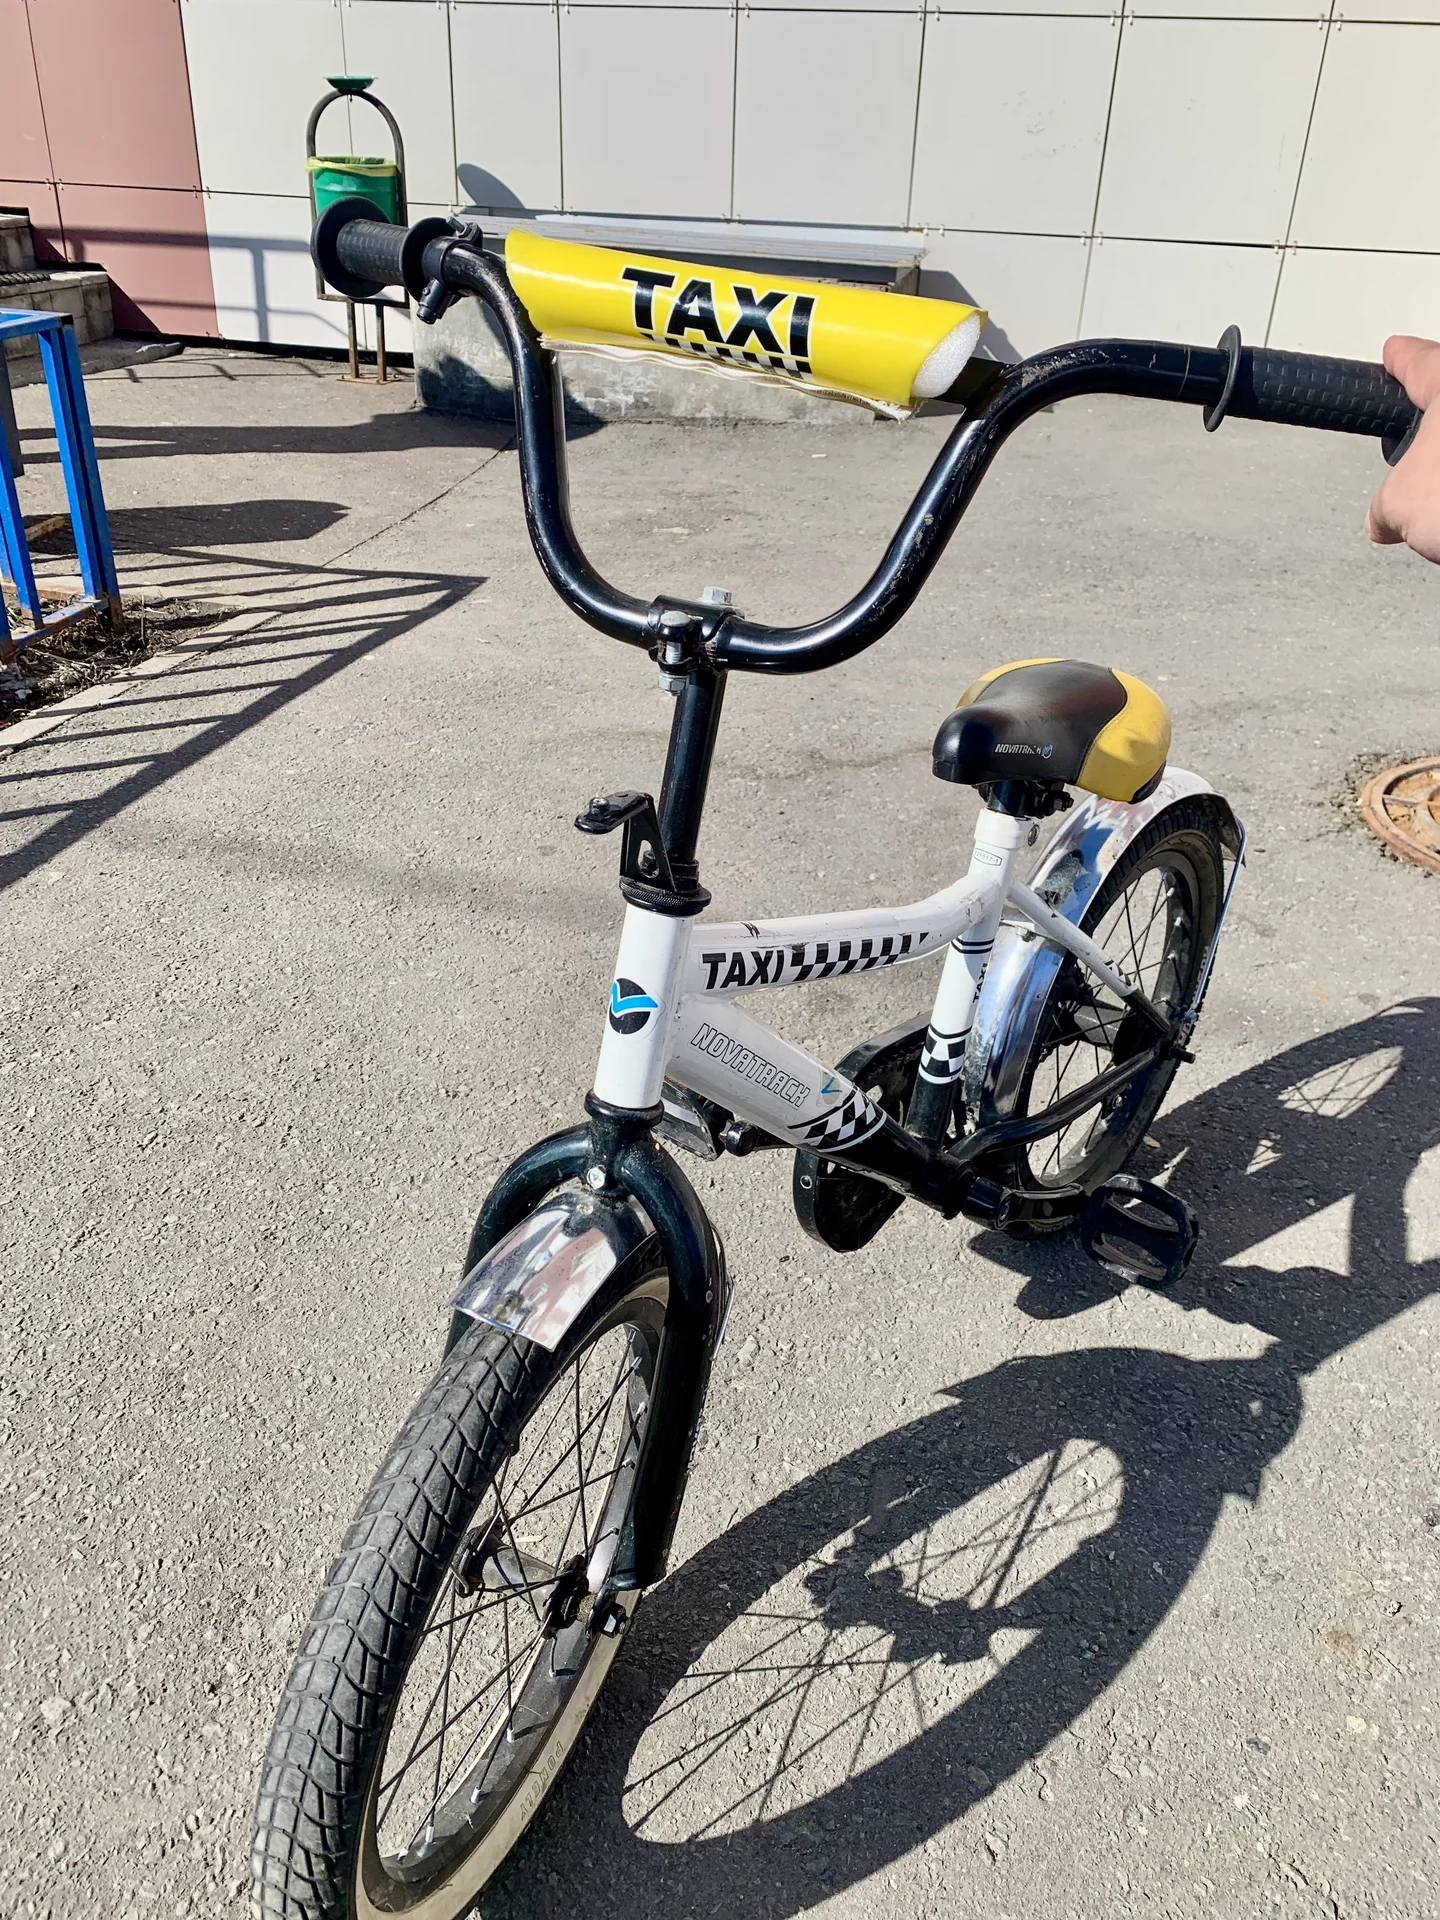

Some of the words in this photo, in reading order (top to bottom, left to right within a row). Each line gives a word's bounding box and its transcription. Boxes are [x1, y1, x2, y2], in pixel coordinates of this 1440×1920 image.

[620, 266, 818, 359] TAXI
[702, 949, 784, 990] TAXI
[972, 962, 988, 1004] TAXI
[690, 1022, 811, 1108] NOVATRACK
[519, 1740, 565, 1822] PONELY
